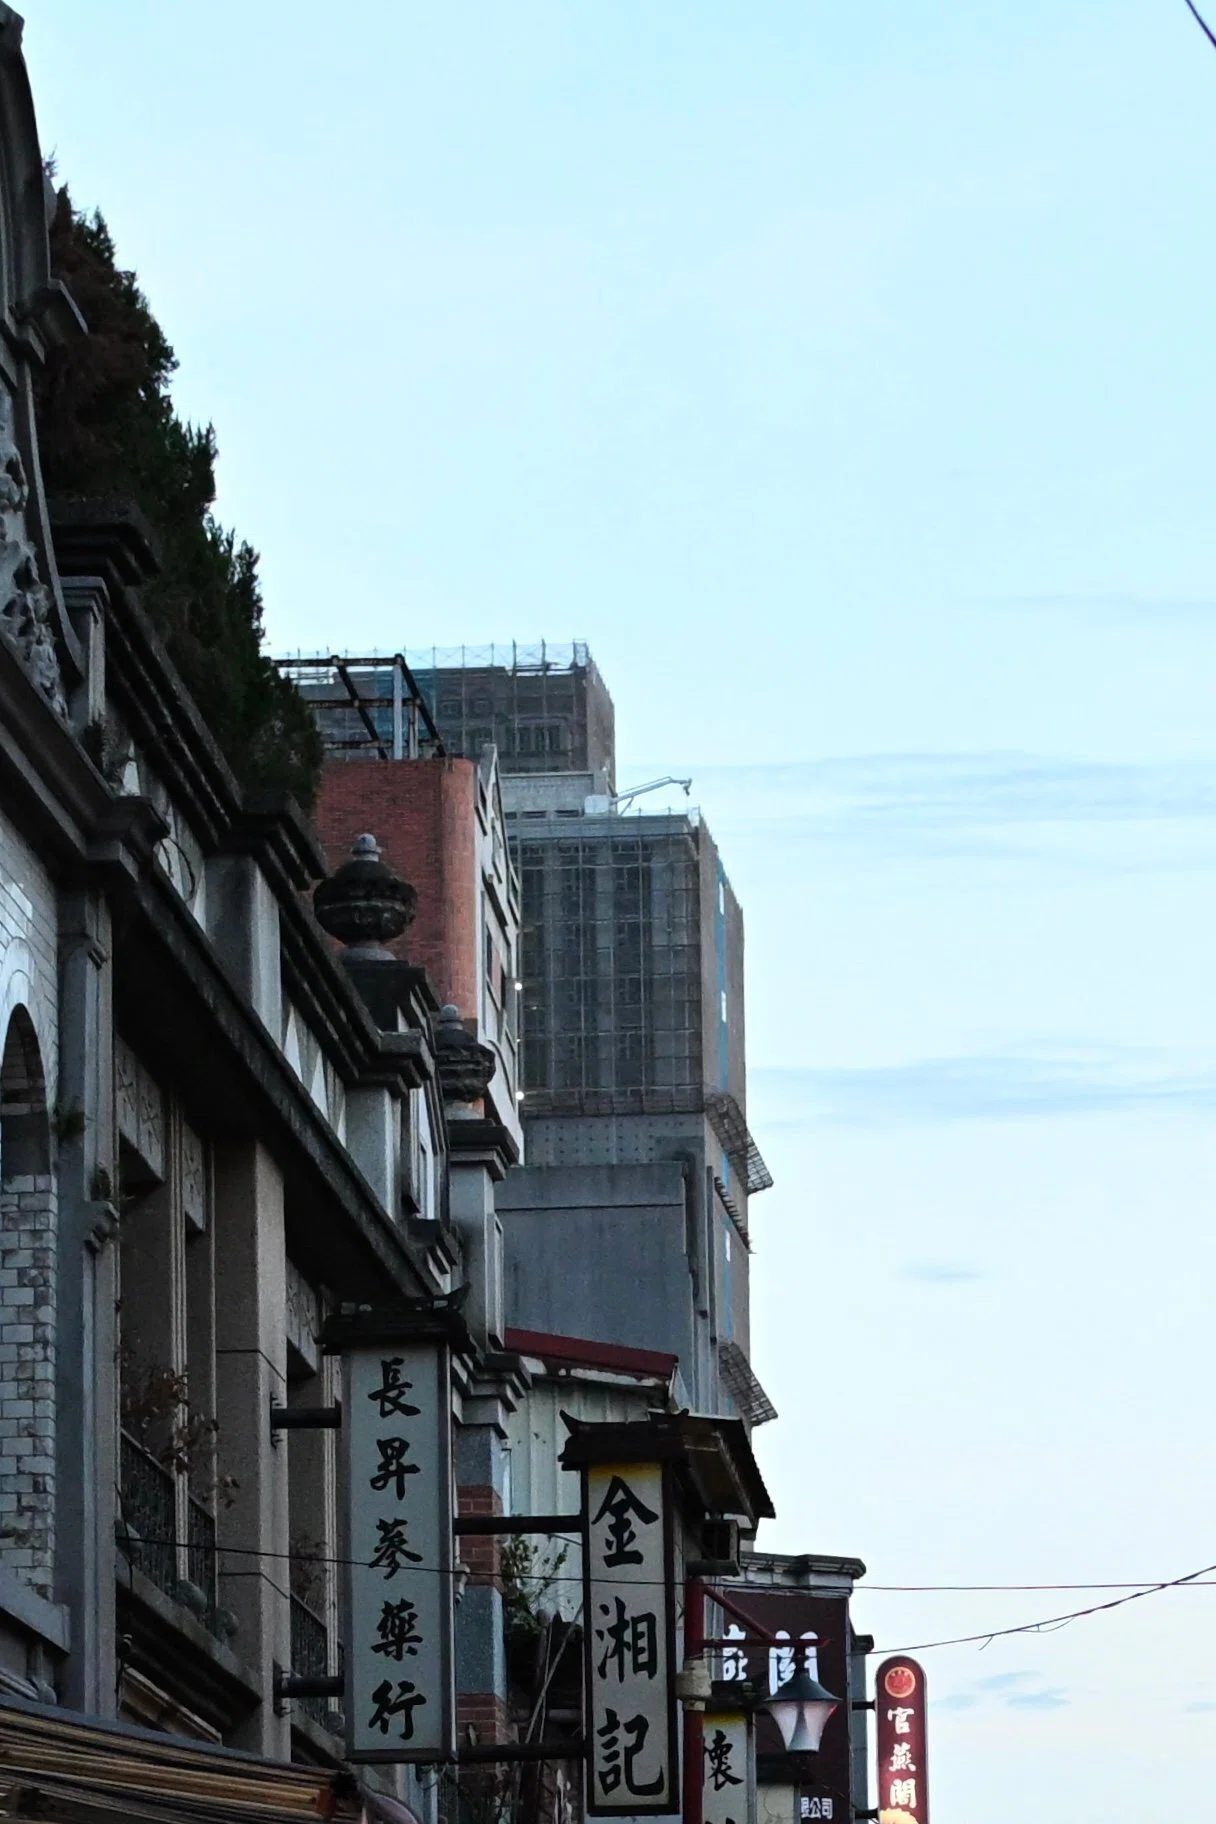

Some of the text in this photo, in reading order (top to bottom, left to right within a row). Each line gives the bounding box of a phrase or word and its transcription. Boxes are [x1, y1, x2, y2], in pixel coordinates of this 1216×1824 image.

[591, 1475, 665, 1797] 金湘記
[887, 1706, 917, 1809] 官燕閣
